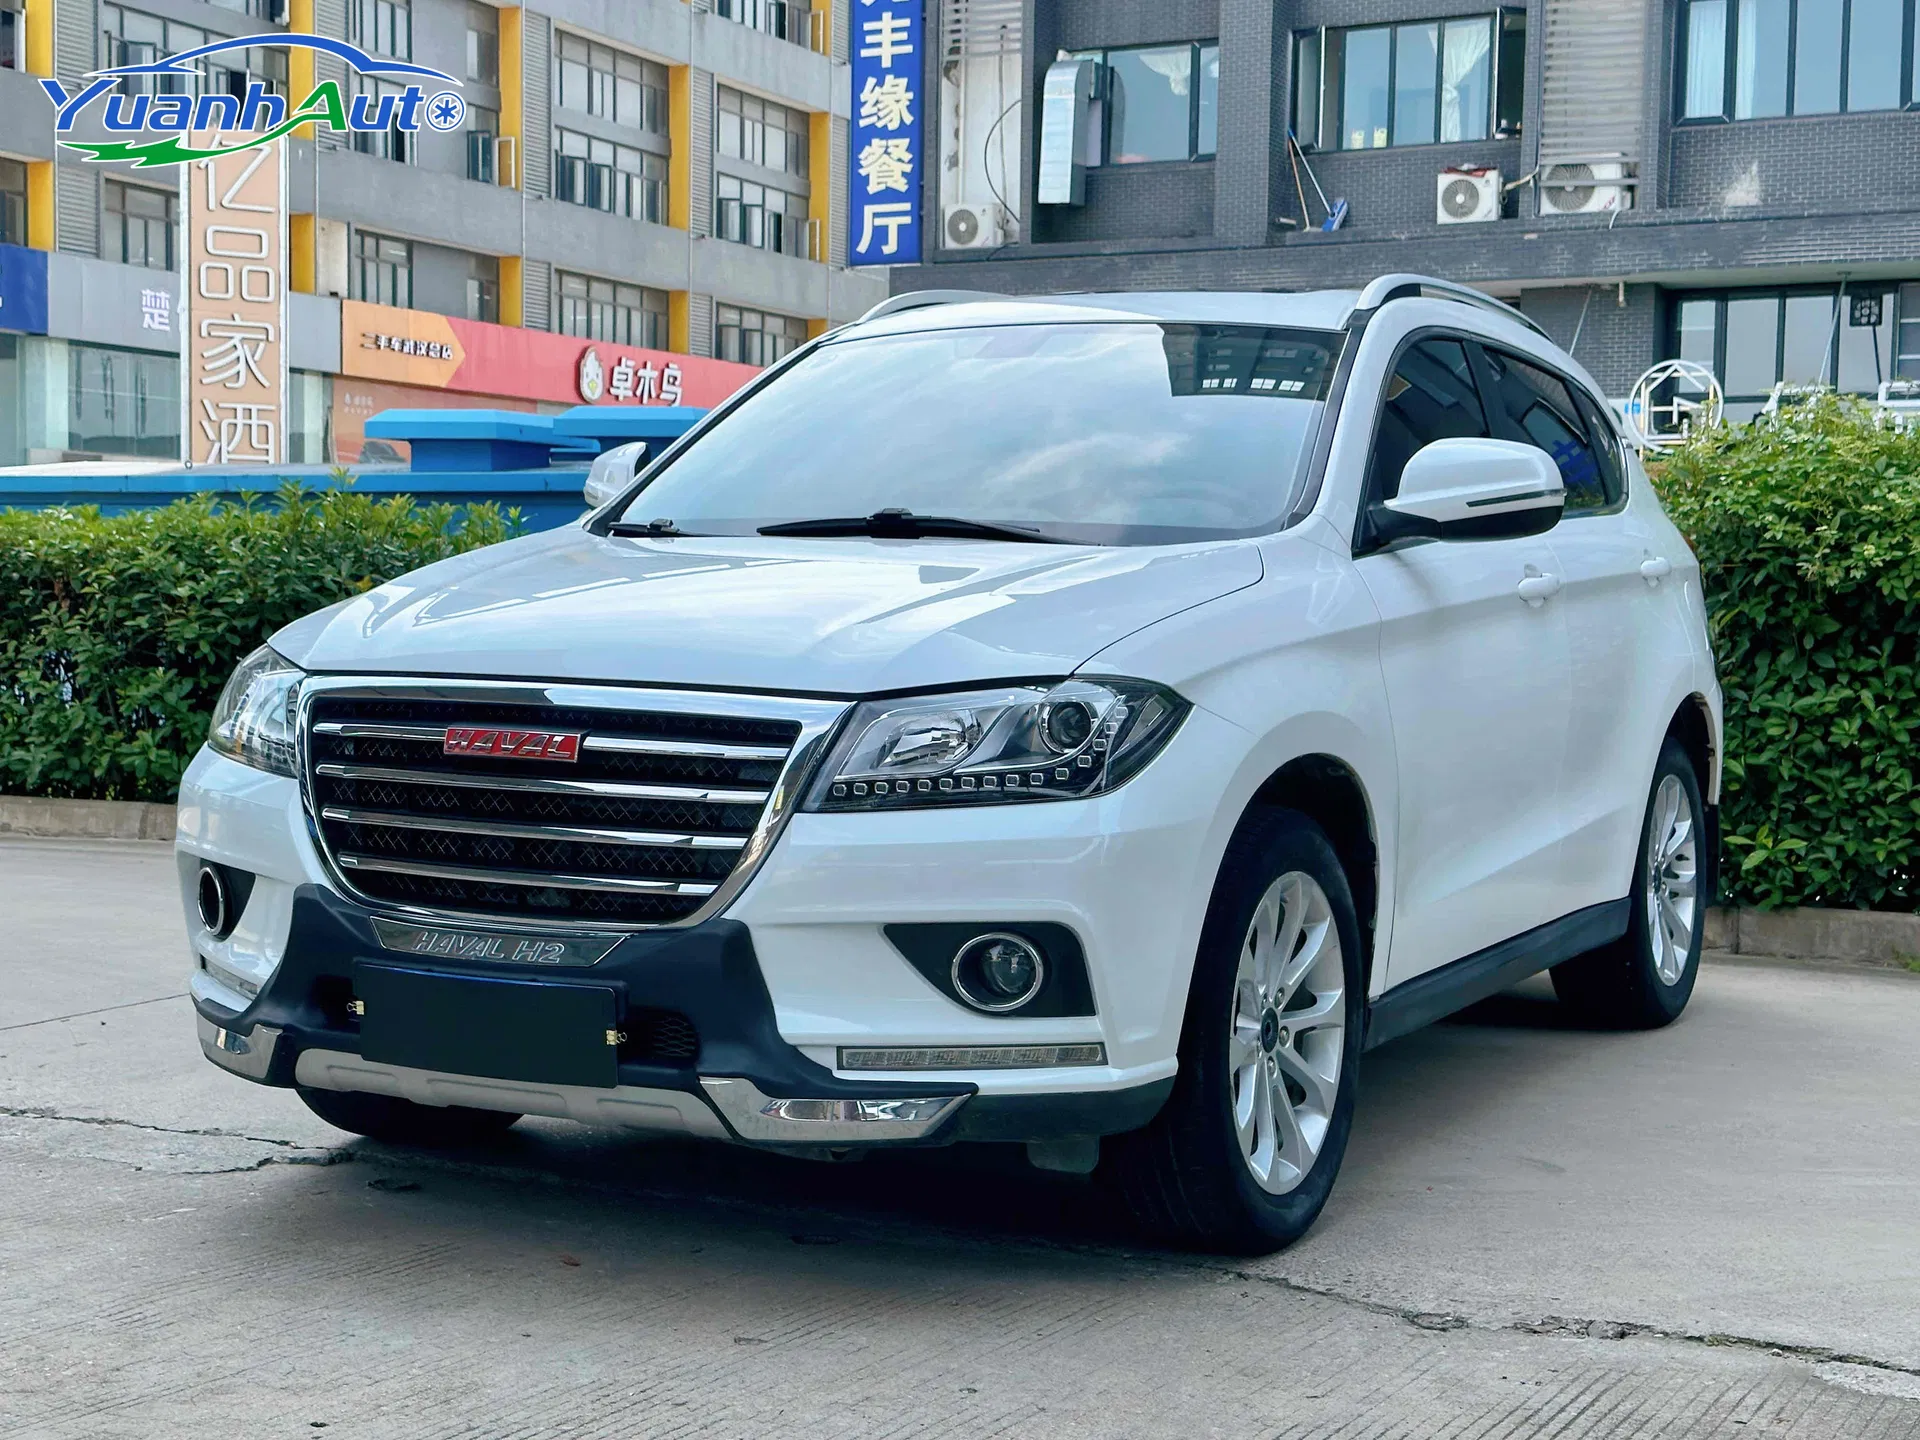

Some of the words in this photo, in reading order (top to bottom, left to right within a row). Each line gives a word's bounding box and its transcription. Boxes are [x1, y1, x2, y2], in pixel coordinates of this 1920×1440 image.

[856, 0, 914, 256] 丰缘餐厅
[141, 288, 170, 332] 楚
[199, 132, 276, 464] 亿品家酒
[360, 332, 453, 361] 二手车武汉总店
[609, 355, 683, 407] 卓木鸟
[447, 729, 572, 759] HAVAL
[411, 931, 505, 960] HAVAL
[511, 939, 566, 964] H2
